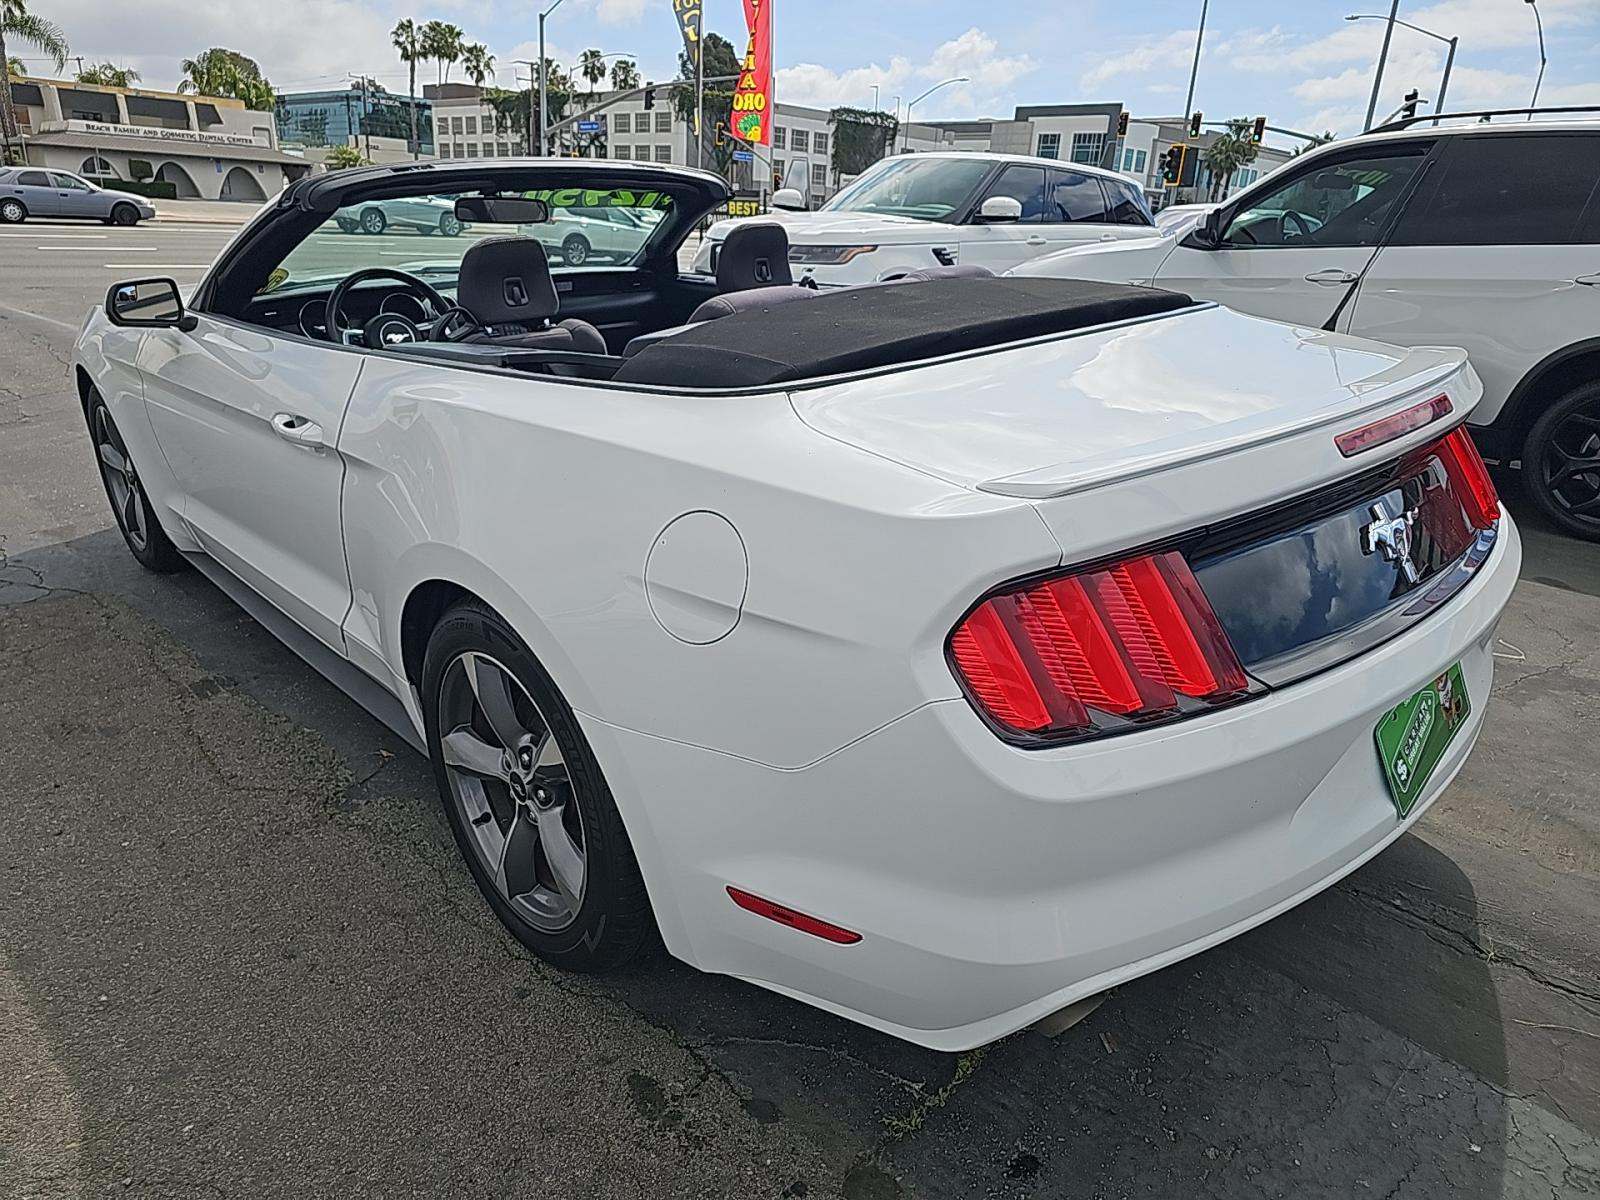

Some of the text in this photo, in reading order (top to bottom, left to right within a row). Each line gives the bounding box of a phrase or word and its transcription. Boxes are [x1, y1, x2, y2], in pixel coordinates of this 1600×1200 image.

[85, 123, 111, 132] BEACH
[113, 126, 141, 135] FAMILY
[160, 130, 196, 140] COSMETIC
[198, 133, 225, 143] DENTAL
[226, 136, 253, 144] CENTER
[728, 201, 758, 215] BEST
